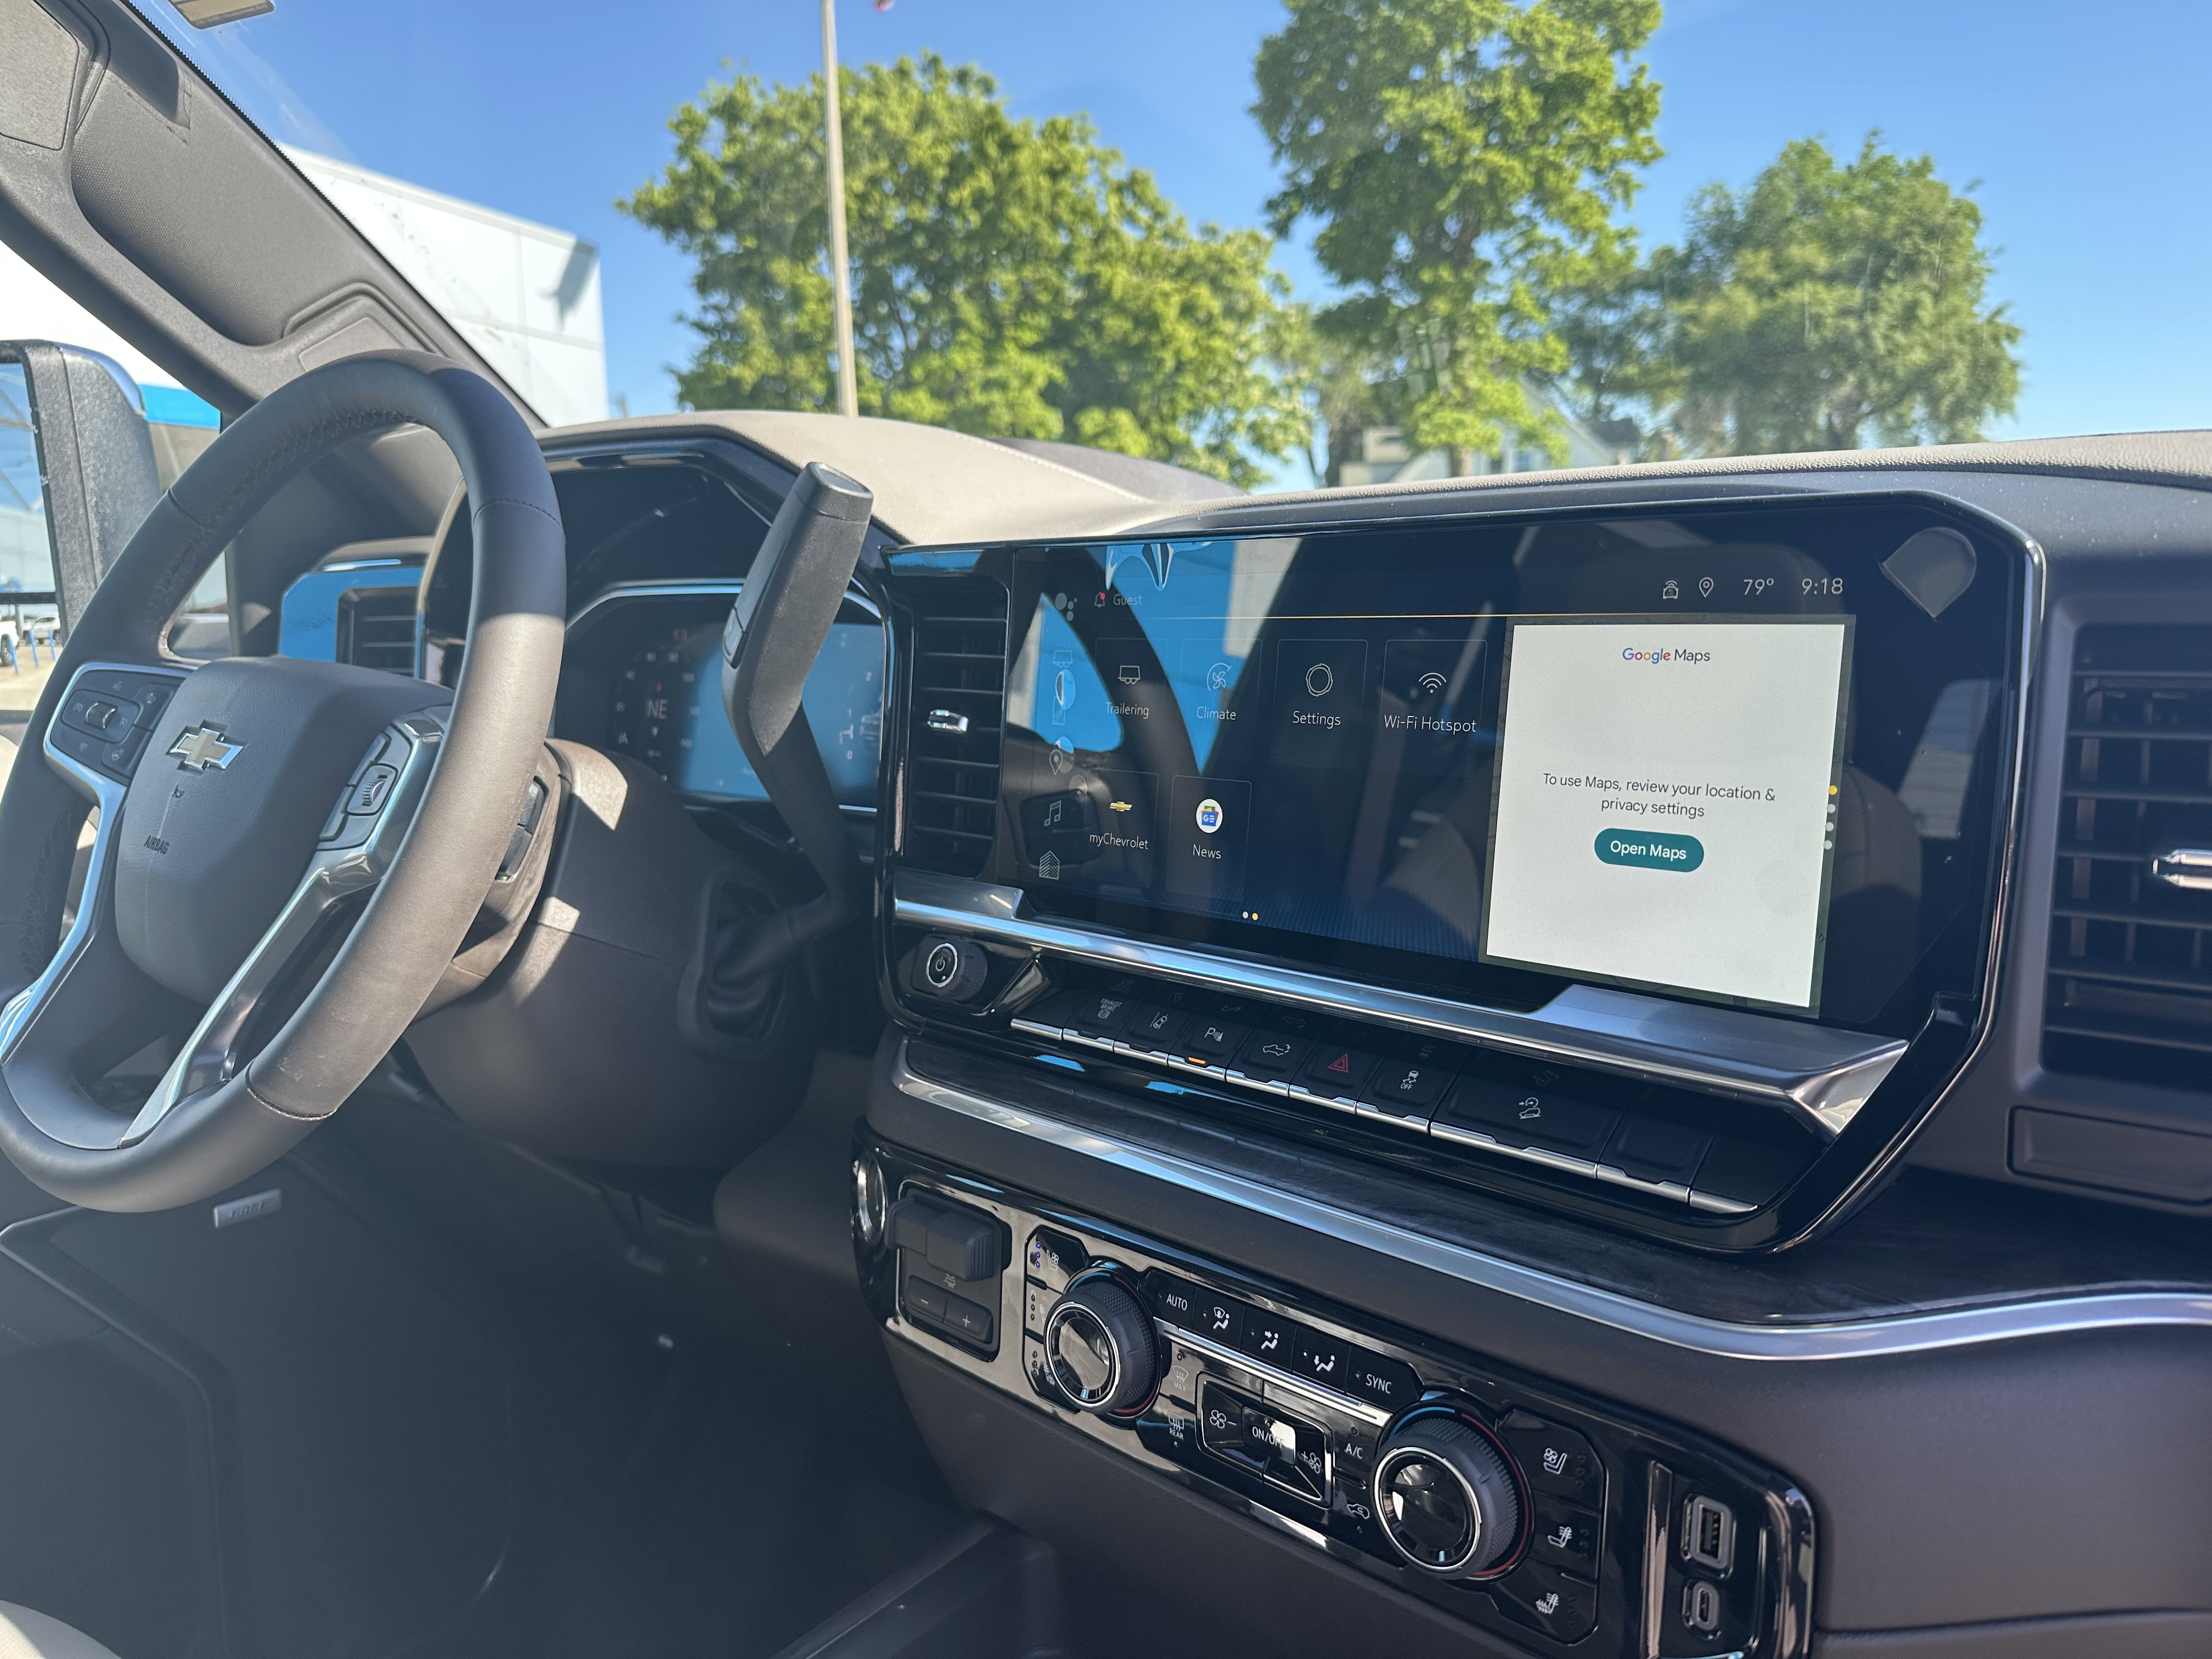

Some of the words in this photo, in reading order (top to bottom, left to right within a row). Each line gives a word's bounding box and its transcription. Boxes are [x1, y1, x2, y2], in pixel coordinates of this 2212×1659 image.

[1743, 578, 1774, 595] 79°
[1802, 578, 1843, 595] 9:18
[1113, 594, 1143, 606] Guest
[1622, 647, 1671, 664] Google
[1674, 648, 1711, 664] Maps
[646, 698, 668, 719] NE
[1105, 702, 1150, 720] Trailering
[1197, 706, 1237, 720] Climate
[1292, 710, 1341, 729] Settings
[1384, 715, 1418, 730] Wi-Fi
[1421, 716, 1477, 735] Hotspot
[1543, 773, 1557, 785] To
[1560, 776, 1582, 787] use
[1585, 776, 1622, 792] Maps,
[1626, 779, 1669, 793] review
[1672, 784, 1702, 797] your
[1706, 783, 1761, 800] location
[1765, 788, 1775, 801] &
[1601, 797, 1648, 814] privacy
[1651, 802, 1705, 819] settings
[144, 835, 170, 854] AIRBAG
[1089, 832, 1149, 850] myChevrolet
[1192, 843, 1222, 860] News
[1610, 840, 1646, 856] Open
[1649, 843, 1686, 862] Maps
[1100, 998, 1122, 1007] EXHAUST
[1100, 1003, 1116, 1012] BRAKE
[1166, 1293, 1188, 1311] AUTO
[1173, 1382, 1186, 1392] MAX
[1365, 1373, 1392, 1394] SYNC
[1169, 1427, 1184, 1441] REAR
[1252, 1426, 1284, 1449] ON/OFF
[1345, 1442, 1363, 1459] A/C
